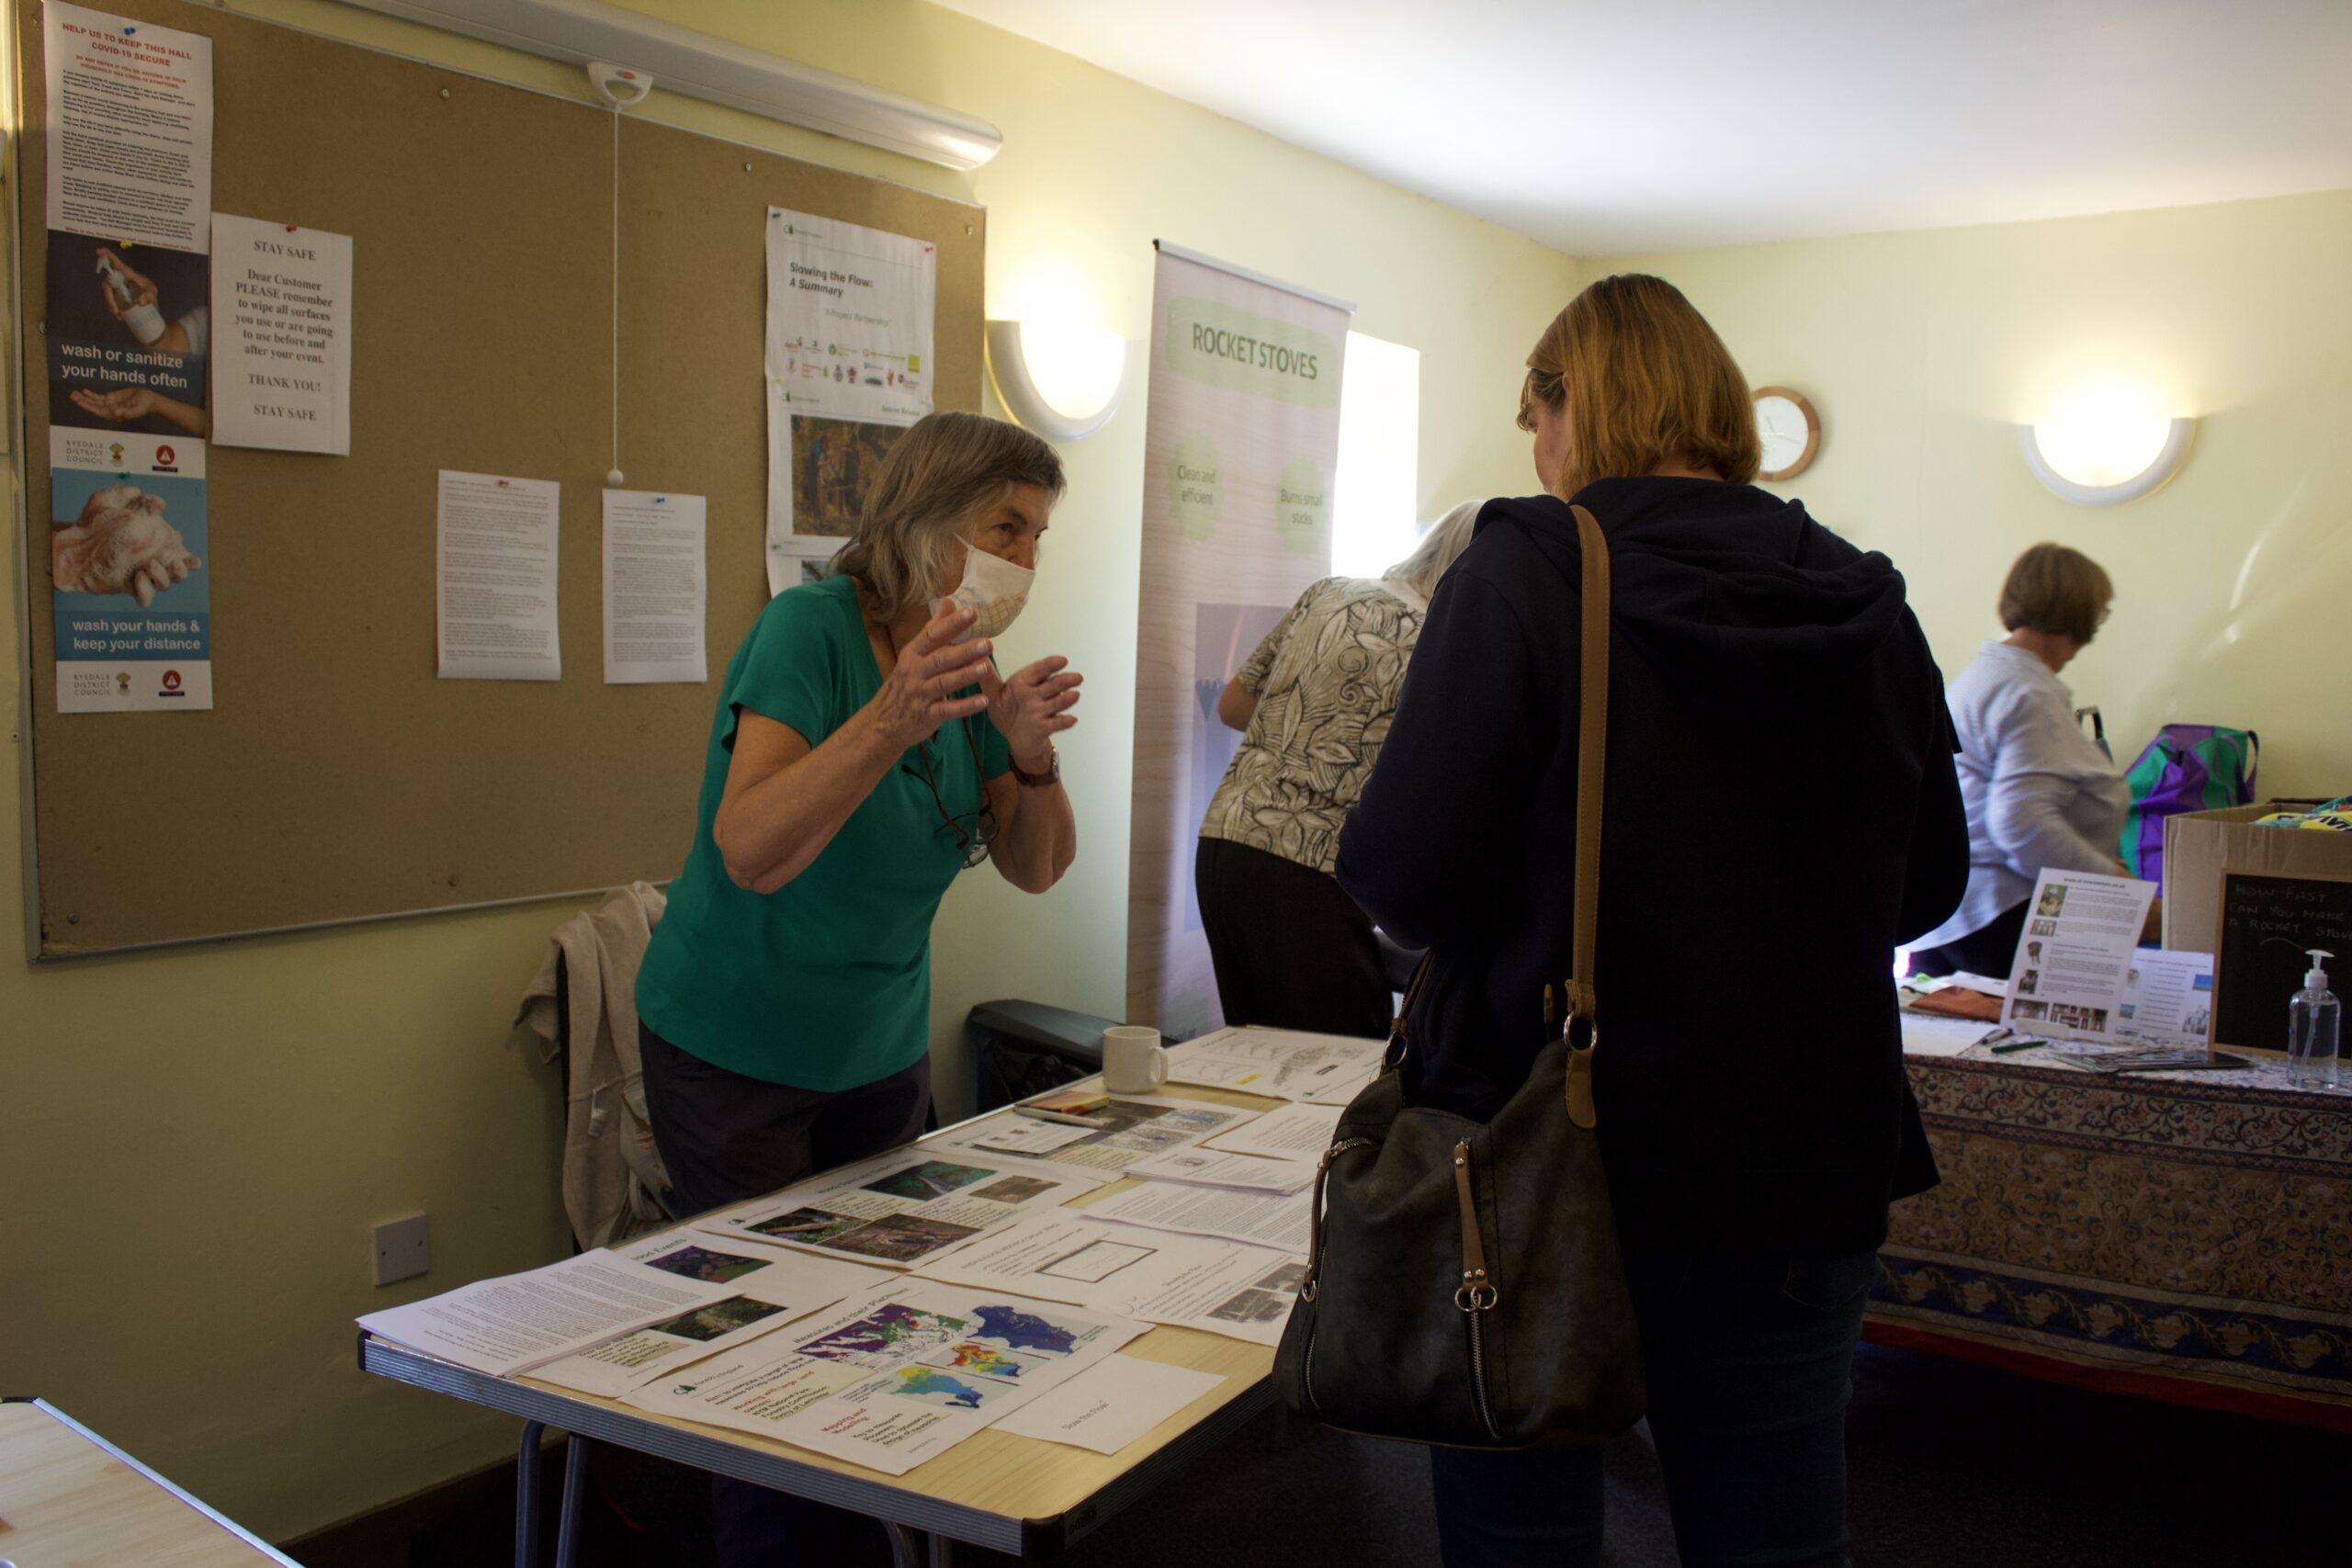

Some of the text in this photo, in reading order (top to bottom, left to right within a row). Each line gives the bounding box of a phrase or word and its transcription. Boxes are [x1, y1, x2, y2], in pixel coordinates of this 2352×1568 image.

[62, 23, 192, 60] HELP US TO KEEP THIS HALL
[92, 42, 171, 66] COVID-19 SECURE
[254, 241, 316, 262] STAY SAFE
[248, 268, 322, 290] Dear Customer
[789, 262, 874, 288] Slowing the Flow:
[236, 282, 333, 307] PLEASE remember
[789, 277, 844, 299] A Summary
[238, 299, 331, 321] to wipe all surfaces
[235, 314, 333, 338] you use or are going
[243, 330, 325, 350] to use before and
[62, 344, 183, 368] wash or sanitize
[243, 345, 324, 364] after your event.
[1193, 322, 1317, 380] ROCKET STOVES
[62, 365, 187, 389] your hands often
[248, 373, 322, 393] THANK YOU!
[254, 404, 316, 421] STAY SAFE
[66, 447, 103, 456] DISTRICT
[66, 455, 103, 465] COUNCIL
[1177, 465, 1216, 484] Clean and
[1280, 488, 1323, 507] Burns small
[73, 619, 200, 634] wash your hands &
[74, 637, 200, 653] keep your distance
[2286, 886, 2327, 903] FAST
[2230, 902, 2345, 921] CAN YOU MAKE
[2229, 918, 2238, 927] A
